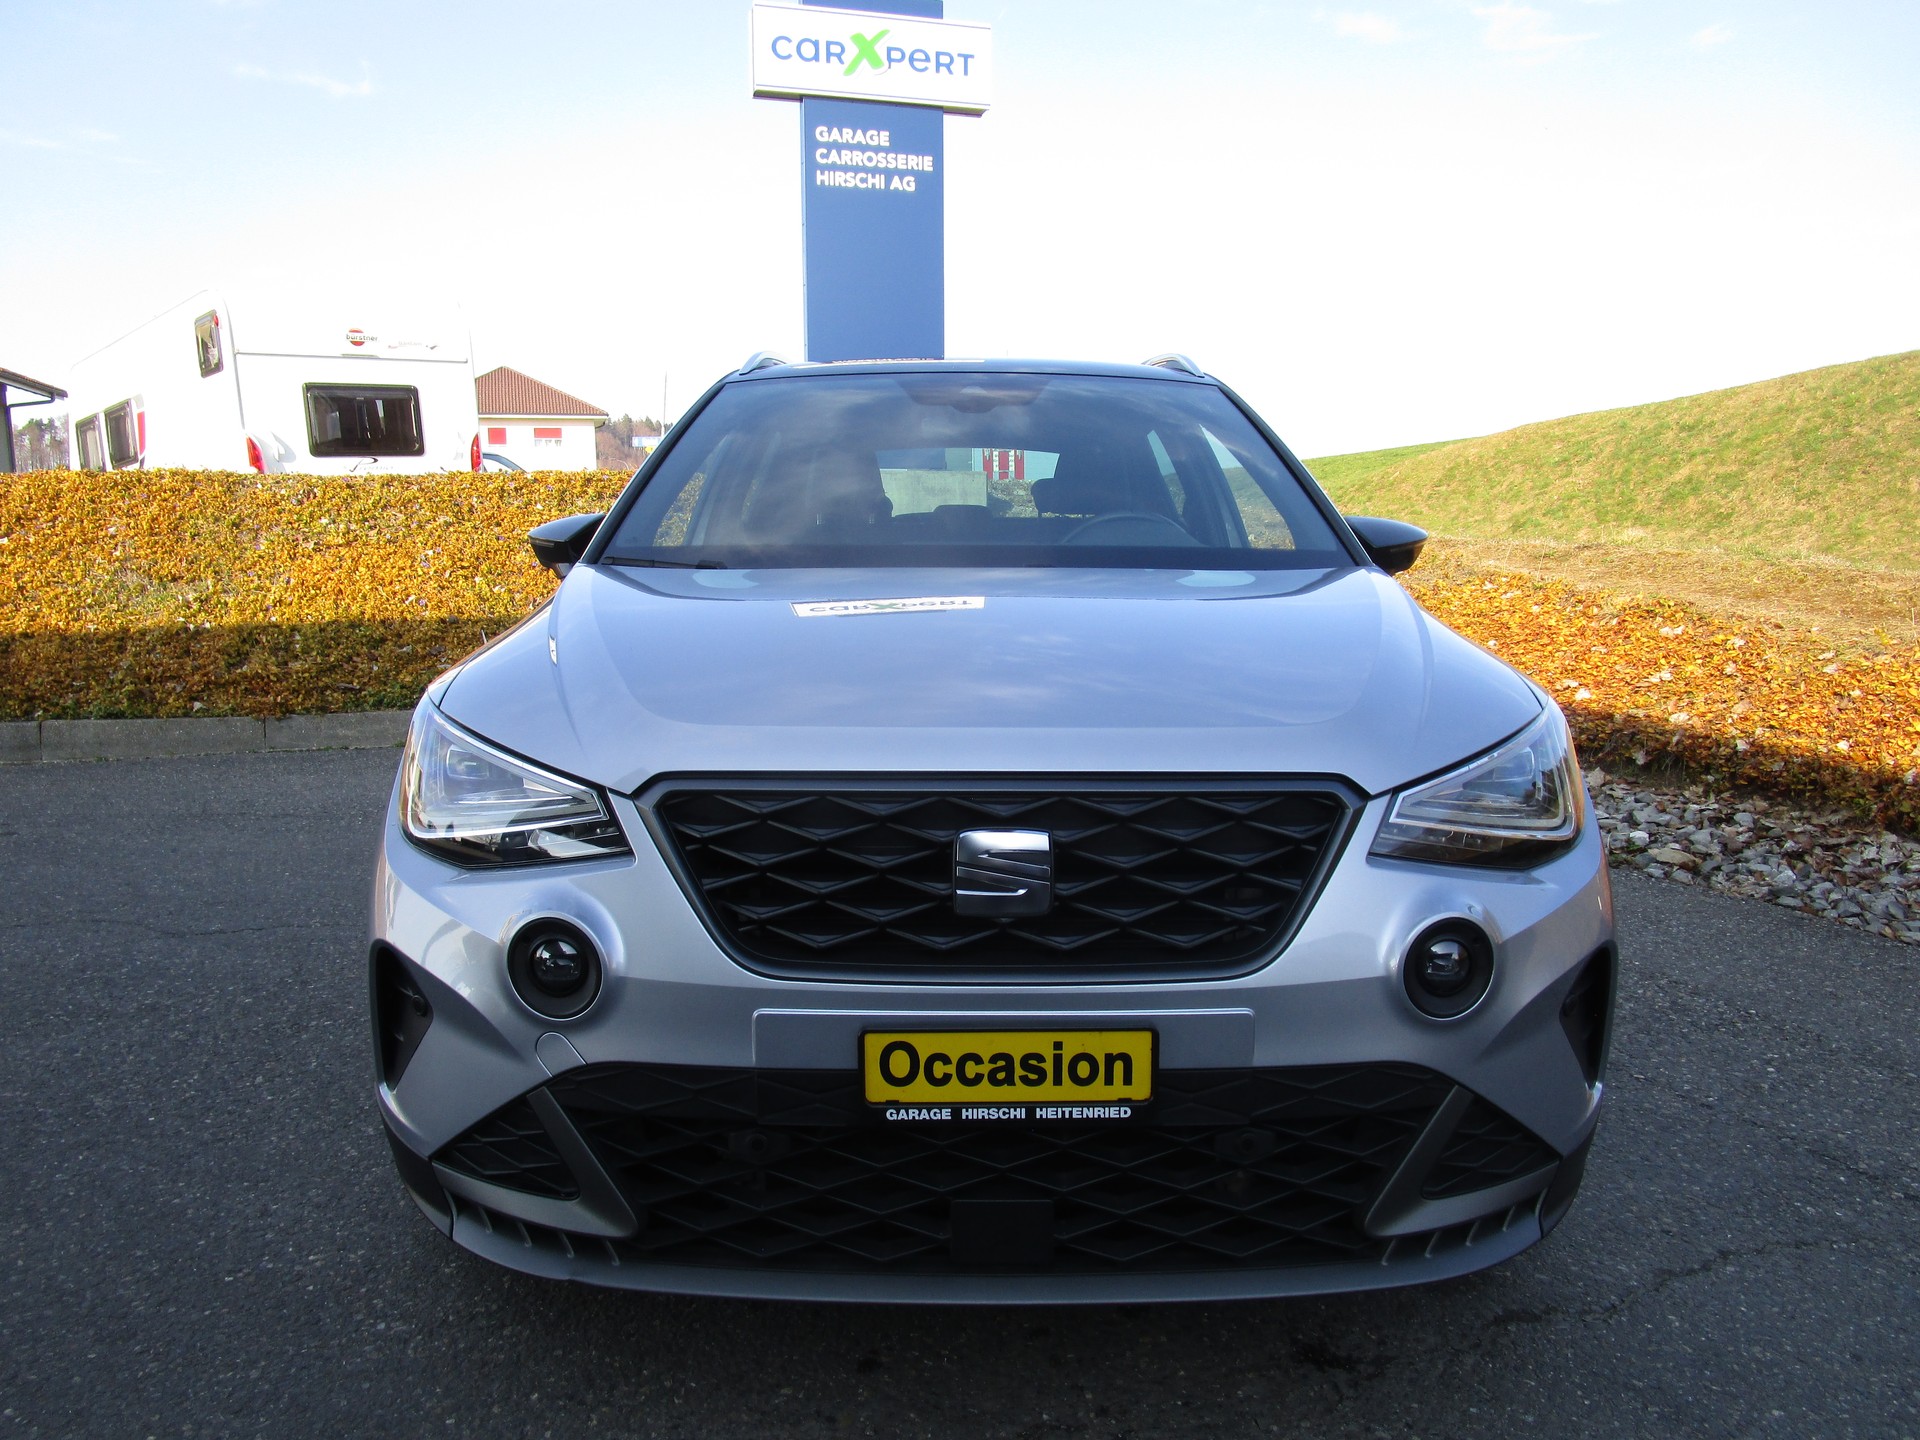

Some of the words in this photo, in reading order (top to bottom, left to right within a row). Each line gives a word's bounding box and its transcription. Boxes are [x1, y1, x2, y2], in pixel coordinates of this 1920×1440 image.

[815, 126, 890, 146] GARAGE
[815, 148, 934, 171] CARROSSERIE
[816, 170, 885, 189] HIRSCHI
[890, 176, 916, 191] AG
[879, 1040, 1134, 1087] Occasion
[886, 1108, 951, 1120] GARAGE
[961, 1107, 1026, 1119] HIRSCHI
[1035, 1106, 1131, 1119] HEITENRIED
